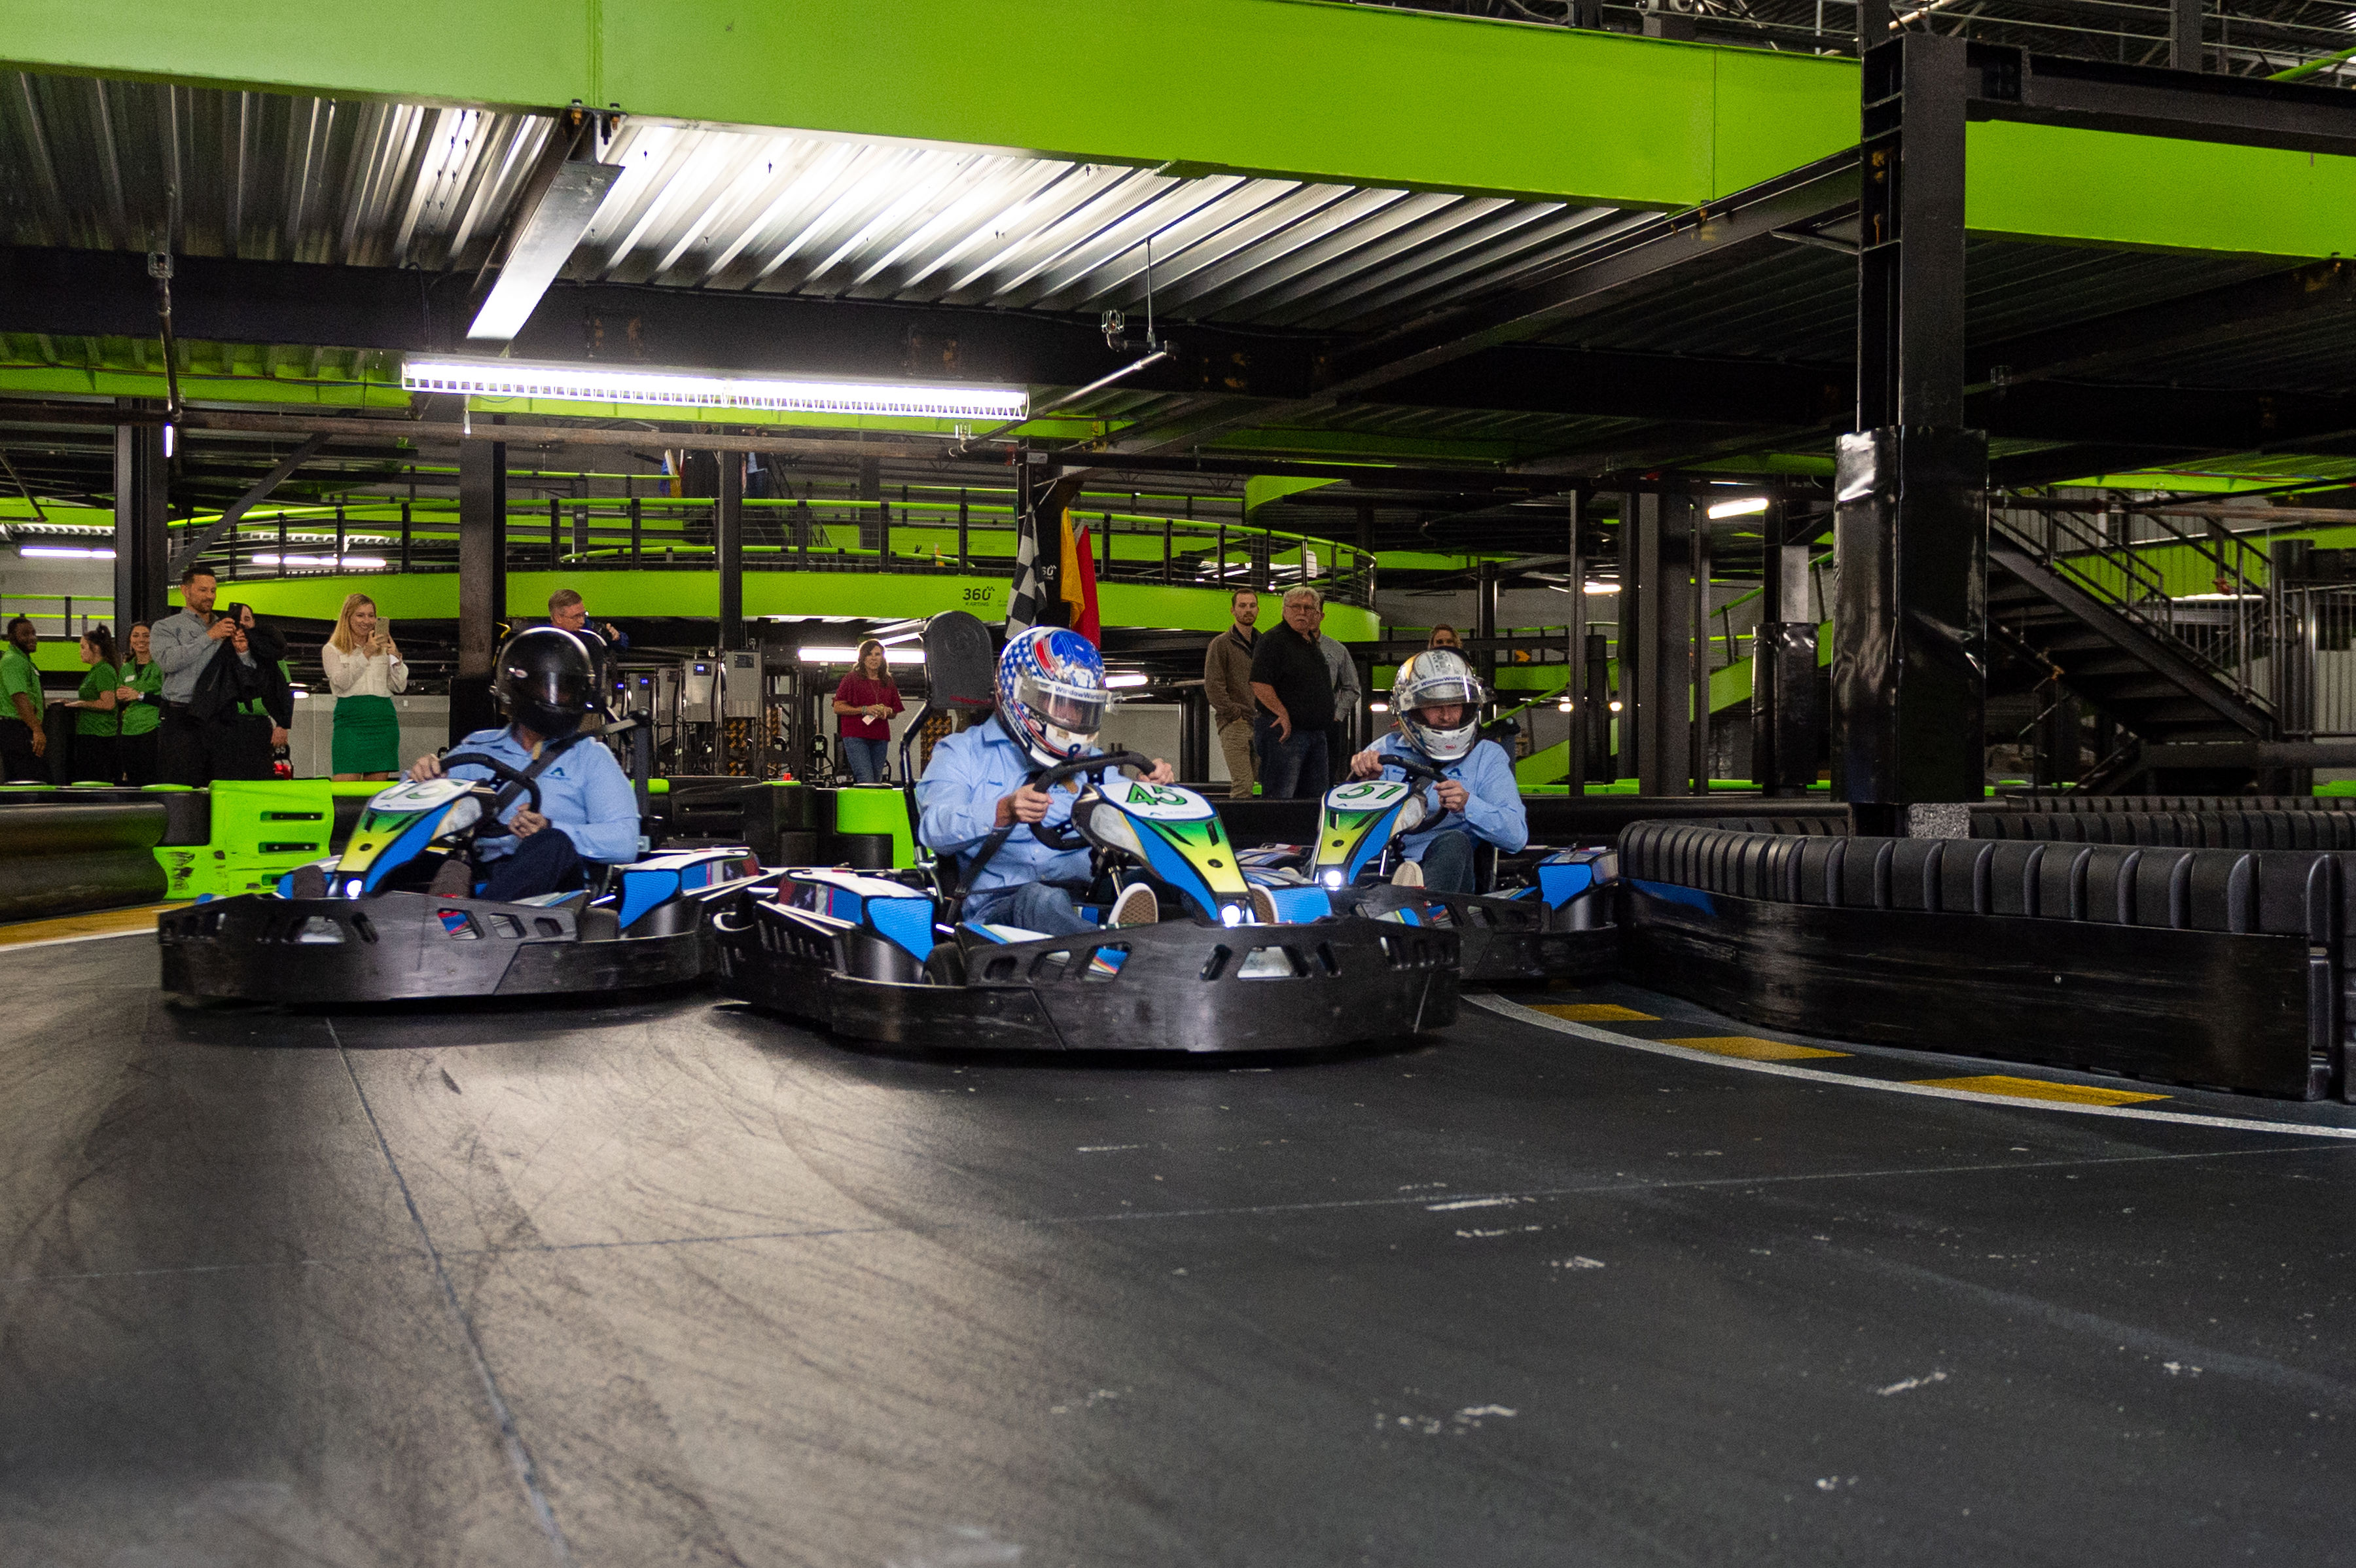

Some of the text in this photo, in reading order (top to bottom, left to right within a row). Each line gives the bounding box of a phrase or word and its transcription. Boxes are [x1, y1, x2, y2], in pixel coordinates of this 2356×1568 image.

[963, 587, 993, 601] 360
[1126, 783, 1188, 806] 45
[1336, 783, 1404, 799] 51
